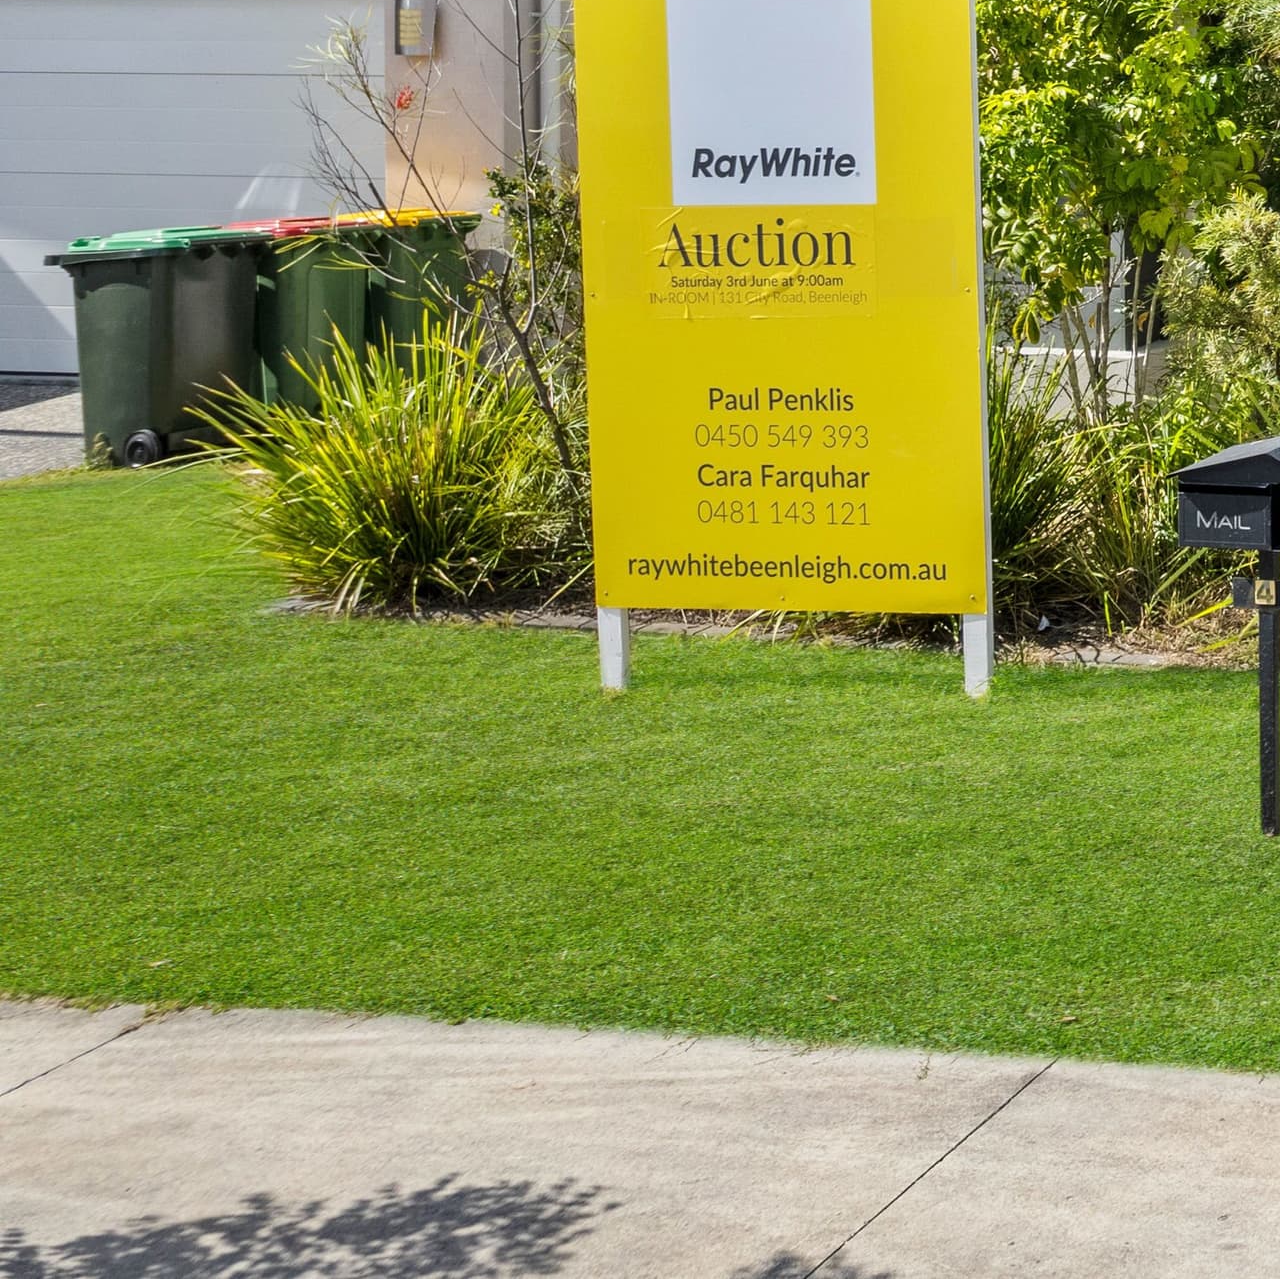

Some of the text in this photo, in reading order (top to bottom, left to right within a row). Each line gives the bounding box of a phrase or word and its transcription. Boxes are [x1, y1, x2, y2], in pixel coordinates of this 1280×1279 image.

[658, 218, 856, 268] Auction
[671, 275, 843, 288] Saturday 3rd June at 9:00am
[809, 291, 867, 305] Beenleigh
[708, 387, 854, 412] Paul Penklis
[694, 424, 869, 449] 0450 549 393
[697, 464, 870, 493] Cara Farquhar
[697, 500, 871, 526] 0481 143 121
[628, 553, 947, 583] raywhitebeenleigh.com.au
[1257, 581, 1274, 603] 4
